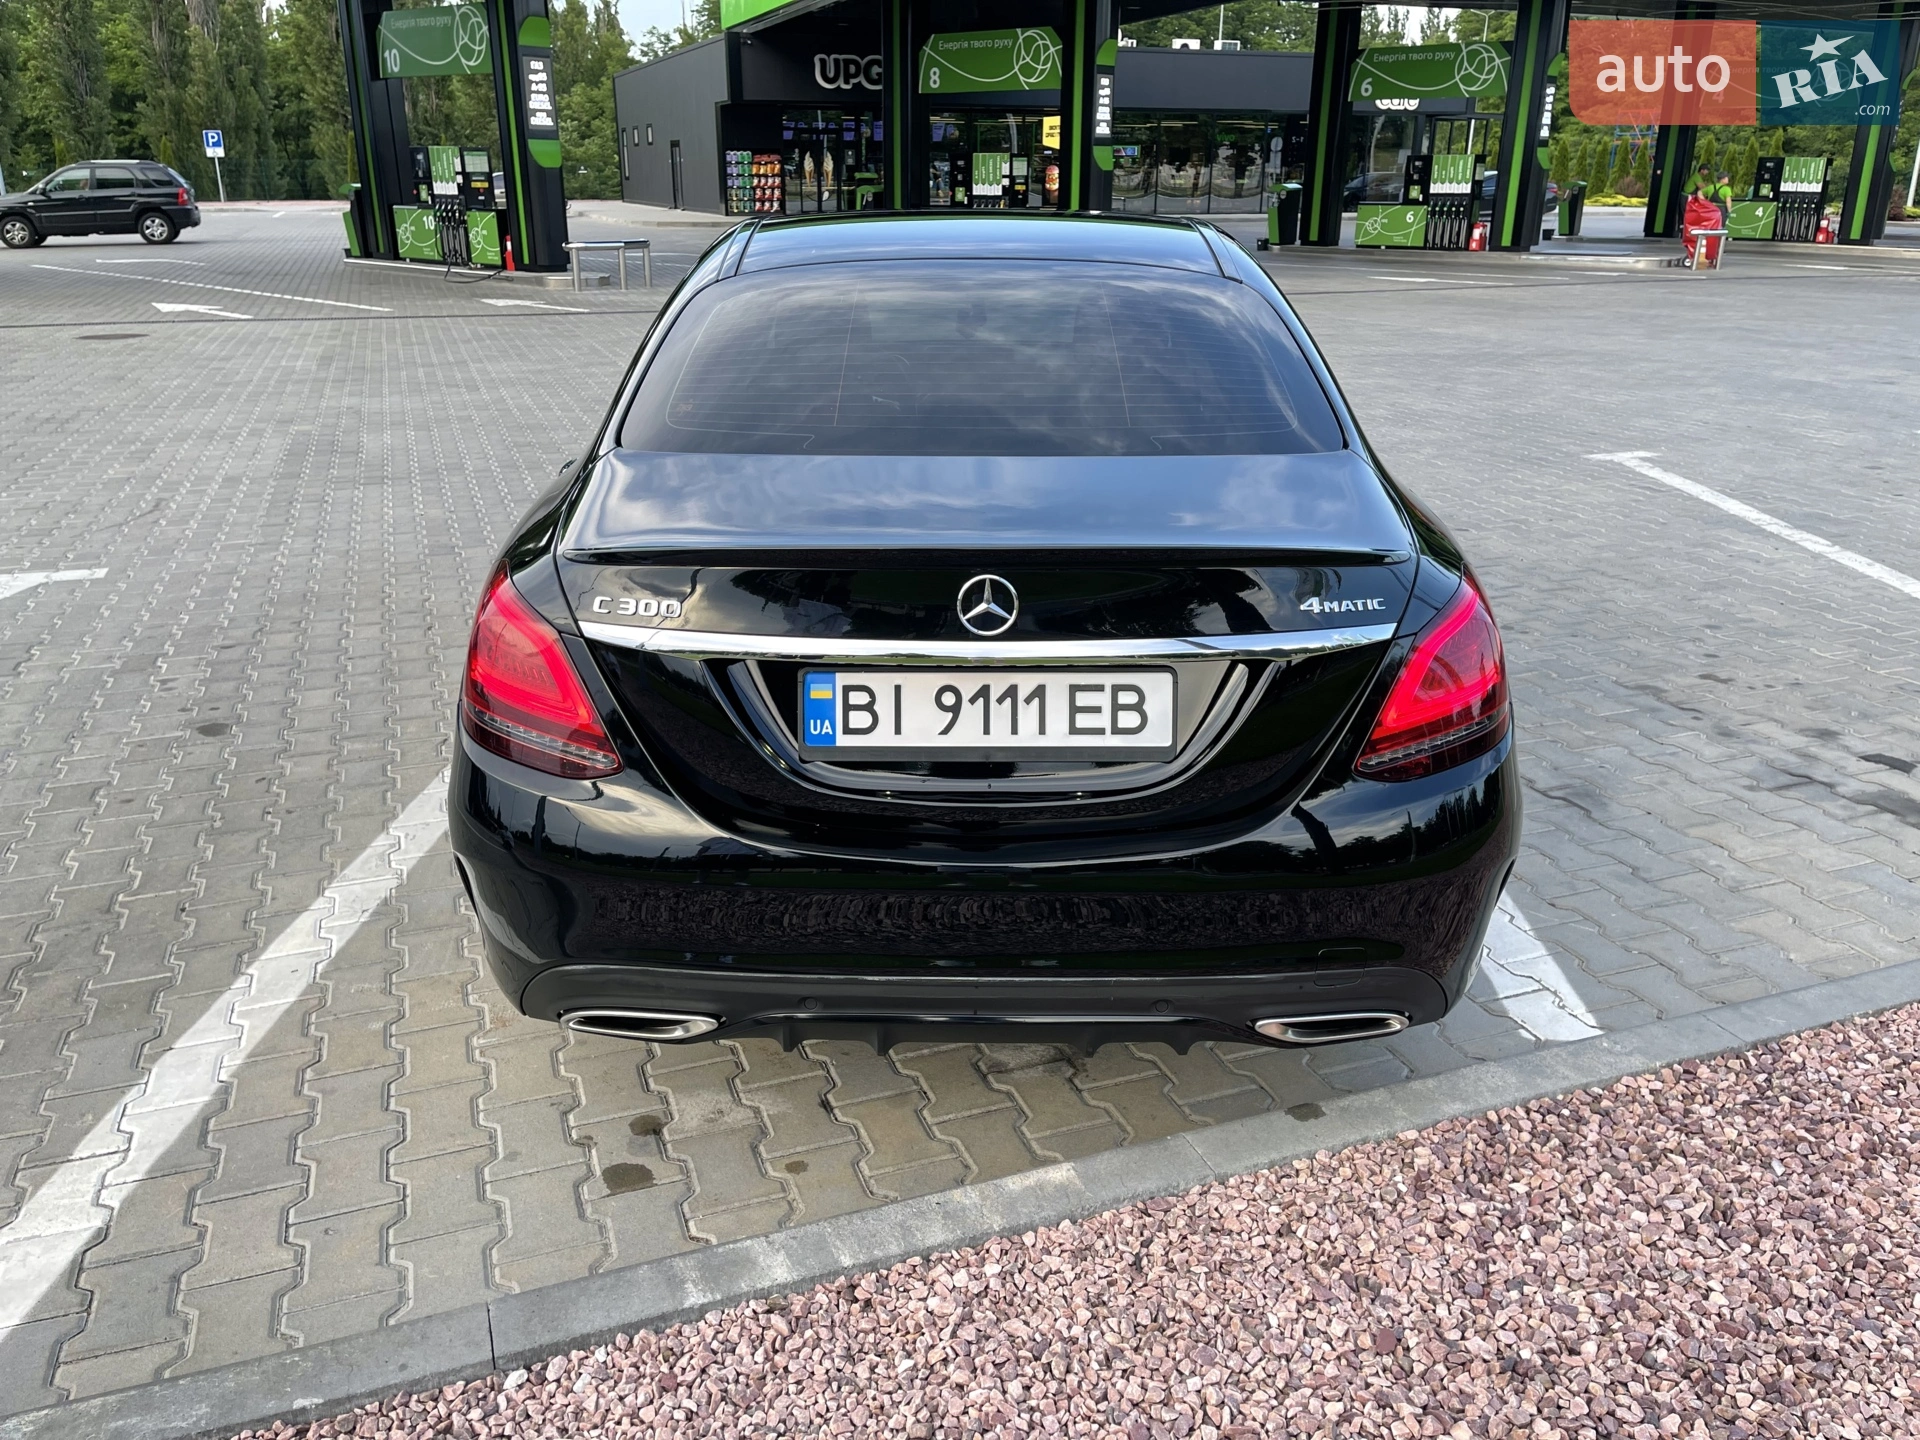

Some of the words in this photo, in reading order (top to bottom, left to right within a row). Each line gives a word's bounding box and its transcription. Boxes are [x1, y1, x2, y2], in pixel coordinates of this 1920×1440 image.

[416, 17, 436, 27] твого
[938, 40, 968, 51] Енергія
[970, 40, 992, 48] твого
[994, 39, 1013, 49] руху
[384, 48, 400, 73] 10
[1373, 52, 1406, 63] Енергія
[1408, 52, 1433, 61] твого
[1435, 51, 1456, 61] руху
[814, 53, 883, 90] UPG
[929, 67, 940, 89] 8
[1360, 77, 1373, 97] 6
[208, 132, 219, 147] P
[1406, 211, 1414, 223] 6
[1755, 206, 1764, 217] 4
[422, 215, 435, 230] 10
[592, 595, 614, 614] C
[616, 597, 682, 618] 300
[1300, 596, 1387, 614] 4MATIC
[841, 684, 902, 736] BI
[933, 684, 1047, 736] 9111
[1068, 684, 1148, 736] EB
[809, 719, 833, 735] UA
